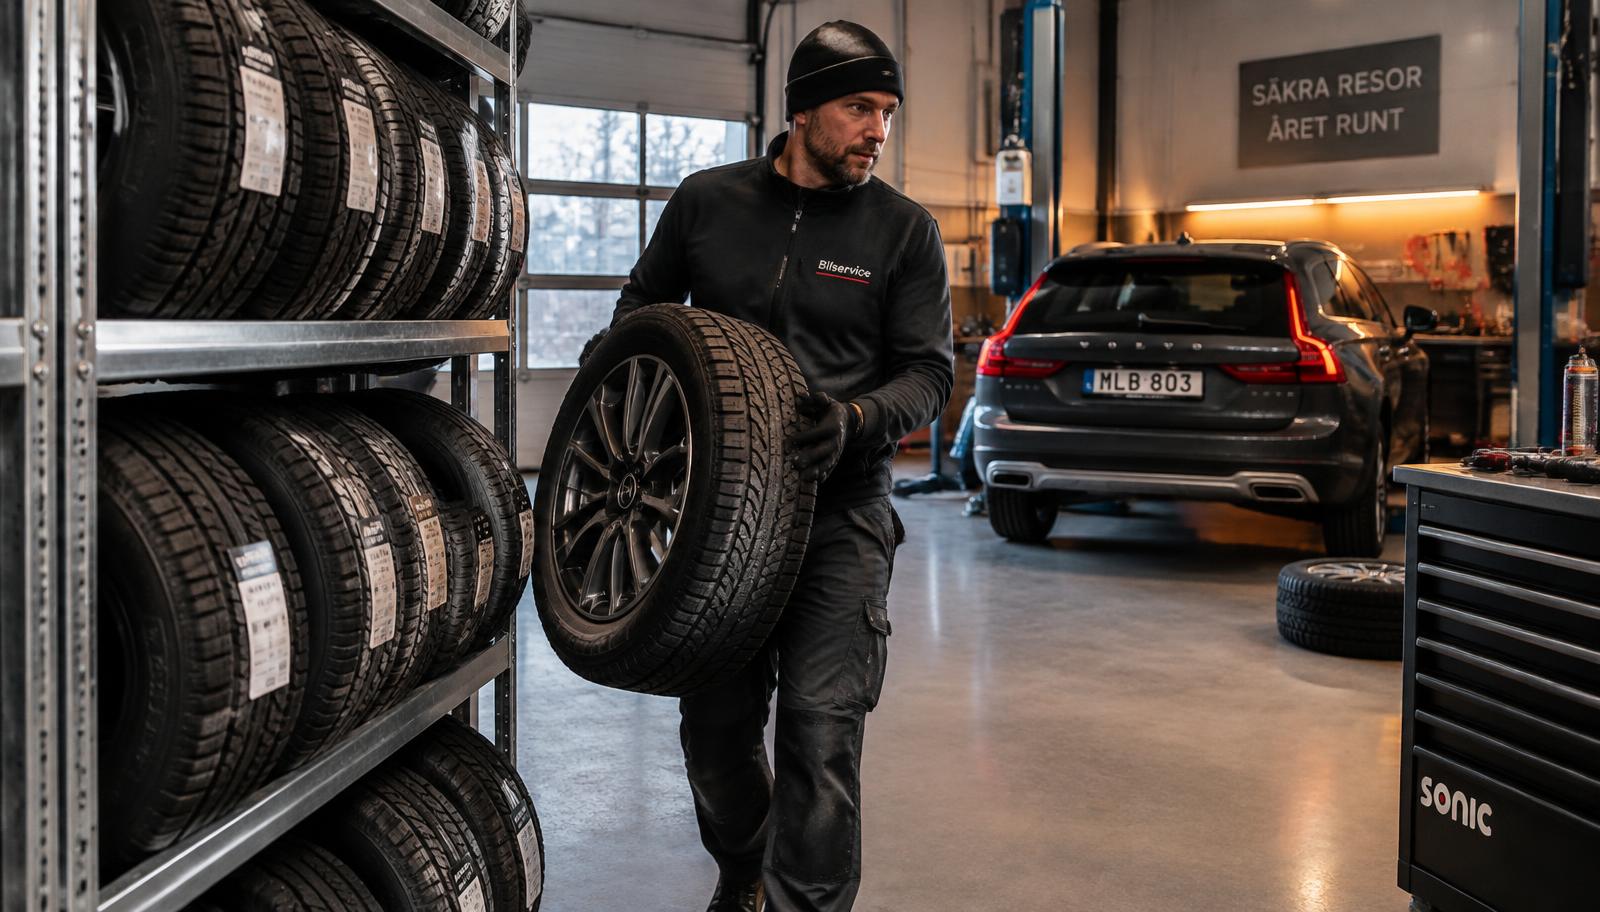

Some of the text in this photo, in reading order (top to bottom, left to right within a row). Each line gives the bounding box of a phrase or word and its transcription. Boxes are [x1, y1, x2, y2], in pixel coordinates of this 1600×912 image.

[1252, 66, 1422, 106] SÄKRA RESOR
[1267, 107, 1404, 142] ÅRET RUNT
[1080, 341, 1203, 351] VOLVO
[1100, 372, 1191, 392] MLB 803
